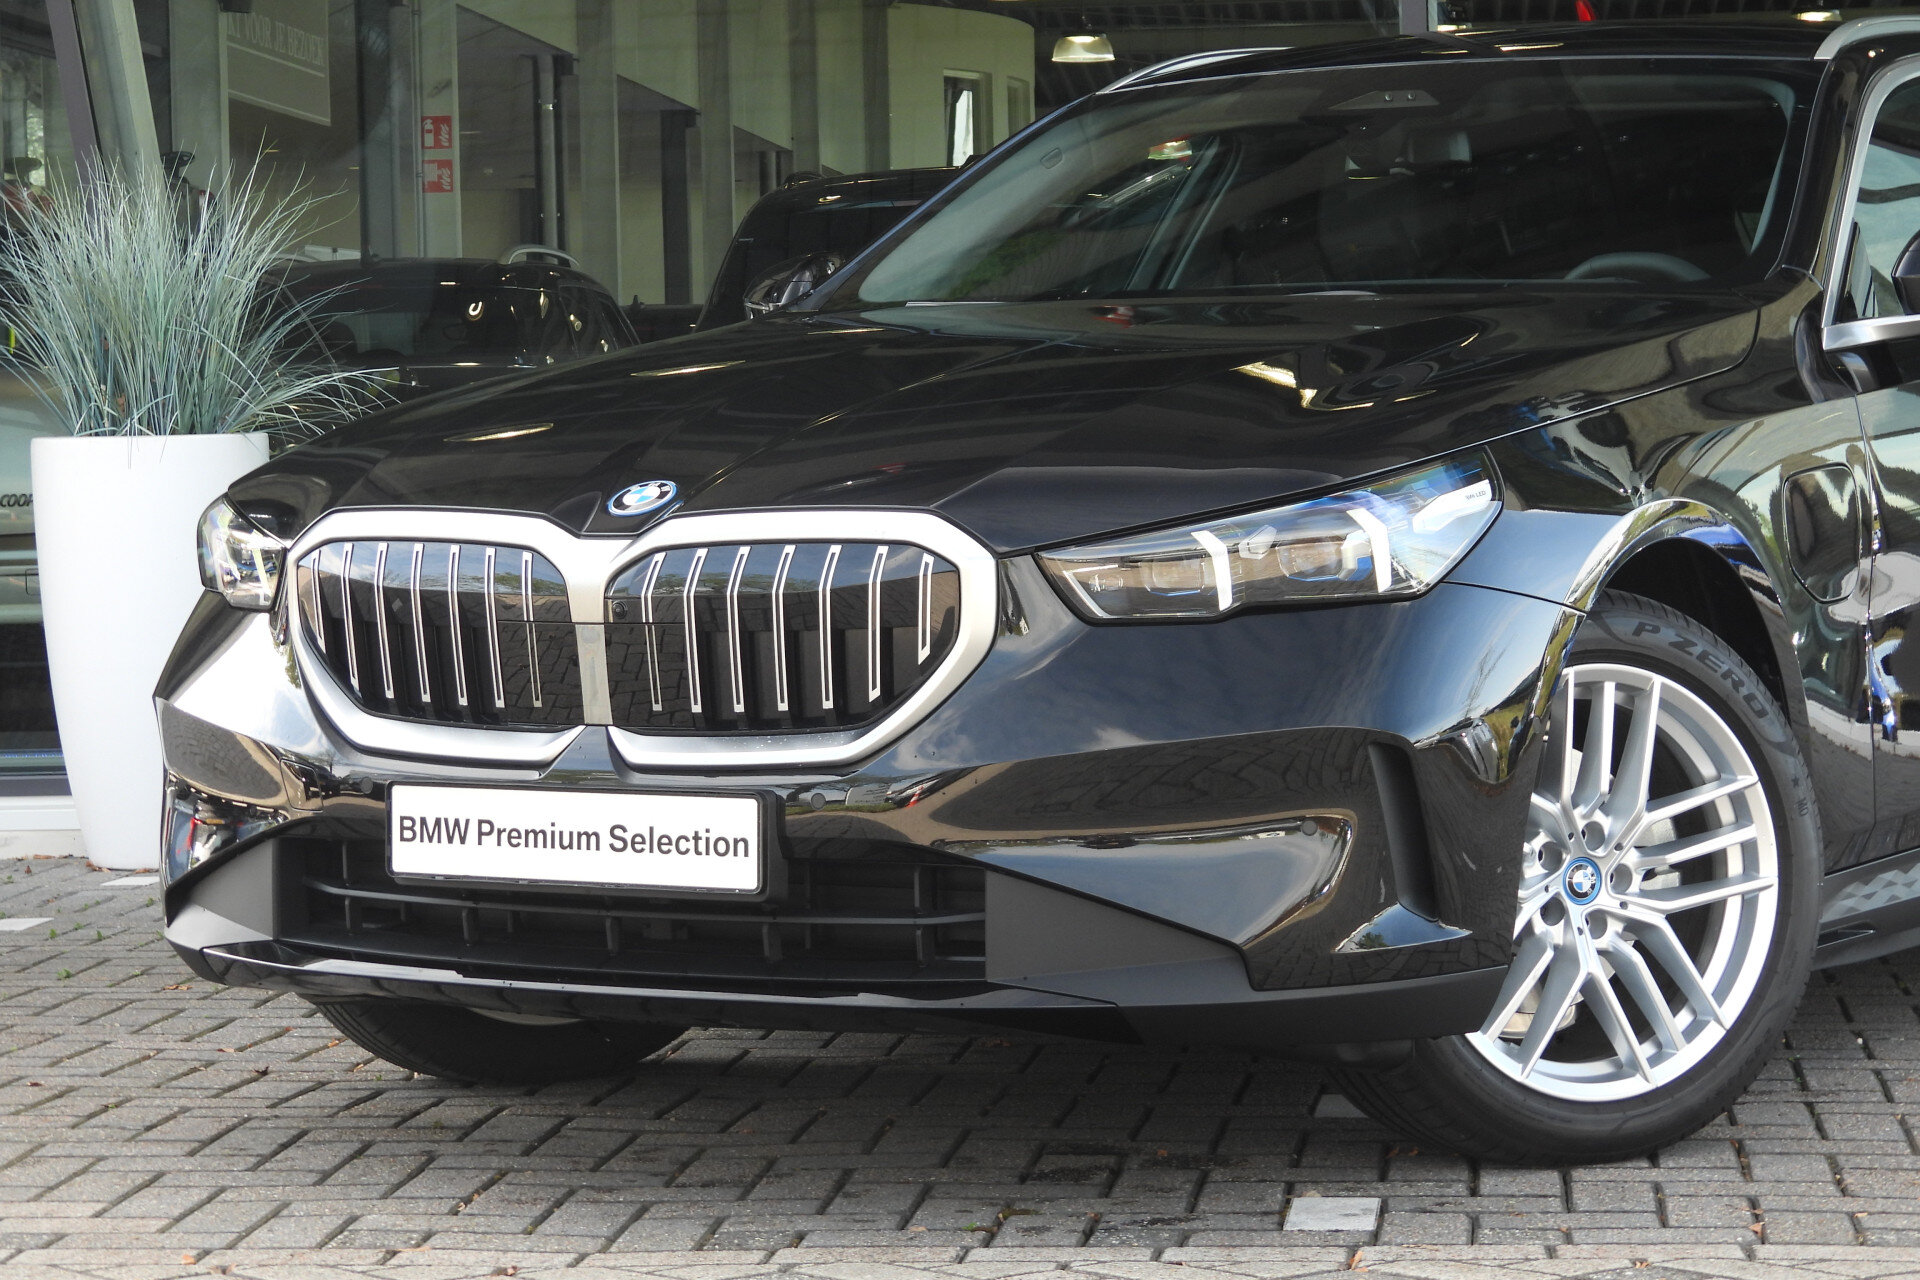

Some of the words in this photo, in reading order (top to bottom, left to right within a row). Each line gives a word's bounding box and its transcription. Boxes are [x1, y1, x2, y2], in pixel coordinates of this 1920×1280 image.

[244, 12, 272, 49] VOOR
[275, 20, 286, 53] JE
[1632, 621, 1661, 637] P
[1668, 633, 1770, 719] ZERO
[399, 815, 470, 845] BMW
[477, 818, 600, 851] Premium
[609, 824, 749, 858] Selection
